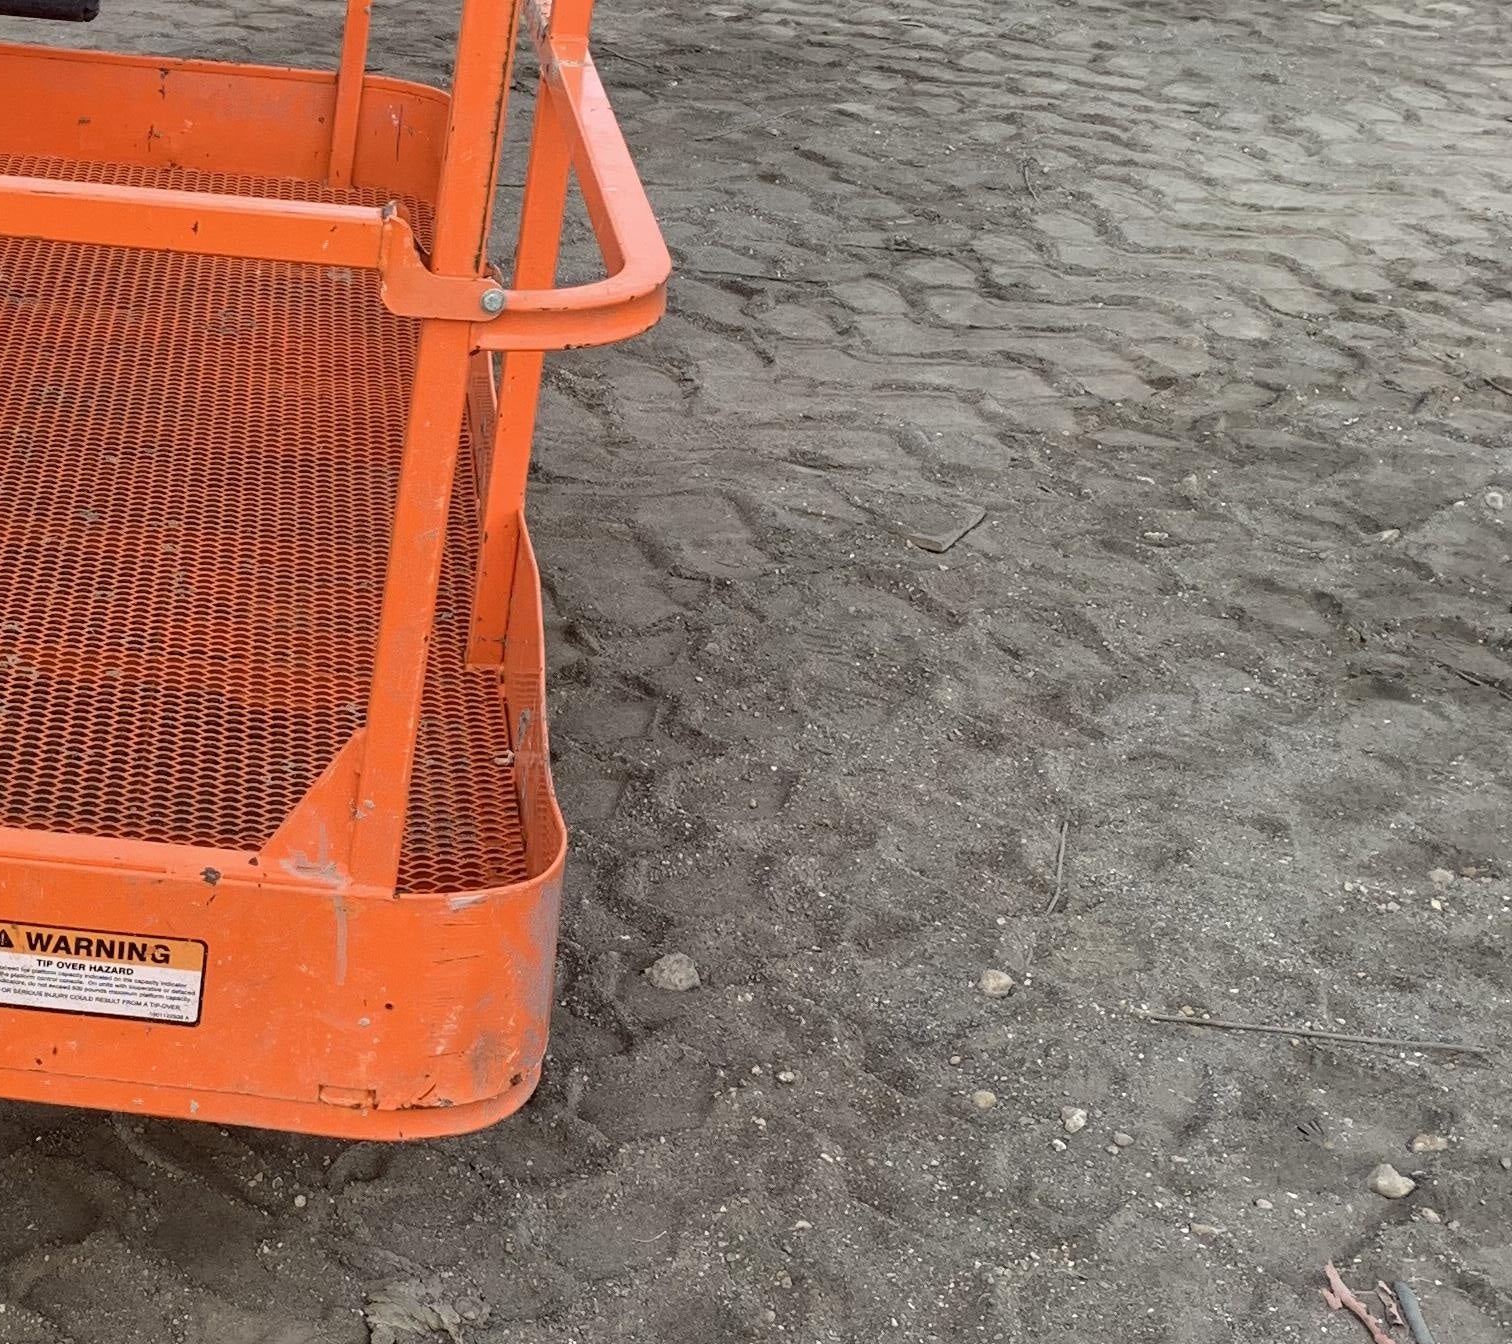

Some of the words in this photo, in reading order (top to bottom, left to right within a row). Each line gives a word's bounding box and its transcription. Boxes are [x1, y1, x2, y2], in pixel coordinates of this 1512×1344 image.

[25, 931, 170, 964] WARNING
[37, 959, 53, 967] TIP
[56, 961, 86, 971] OVER
[89, 964, 134, 975] HAZARD
